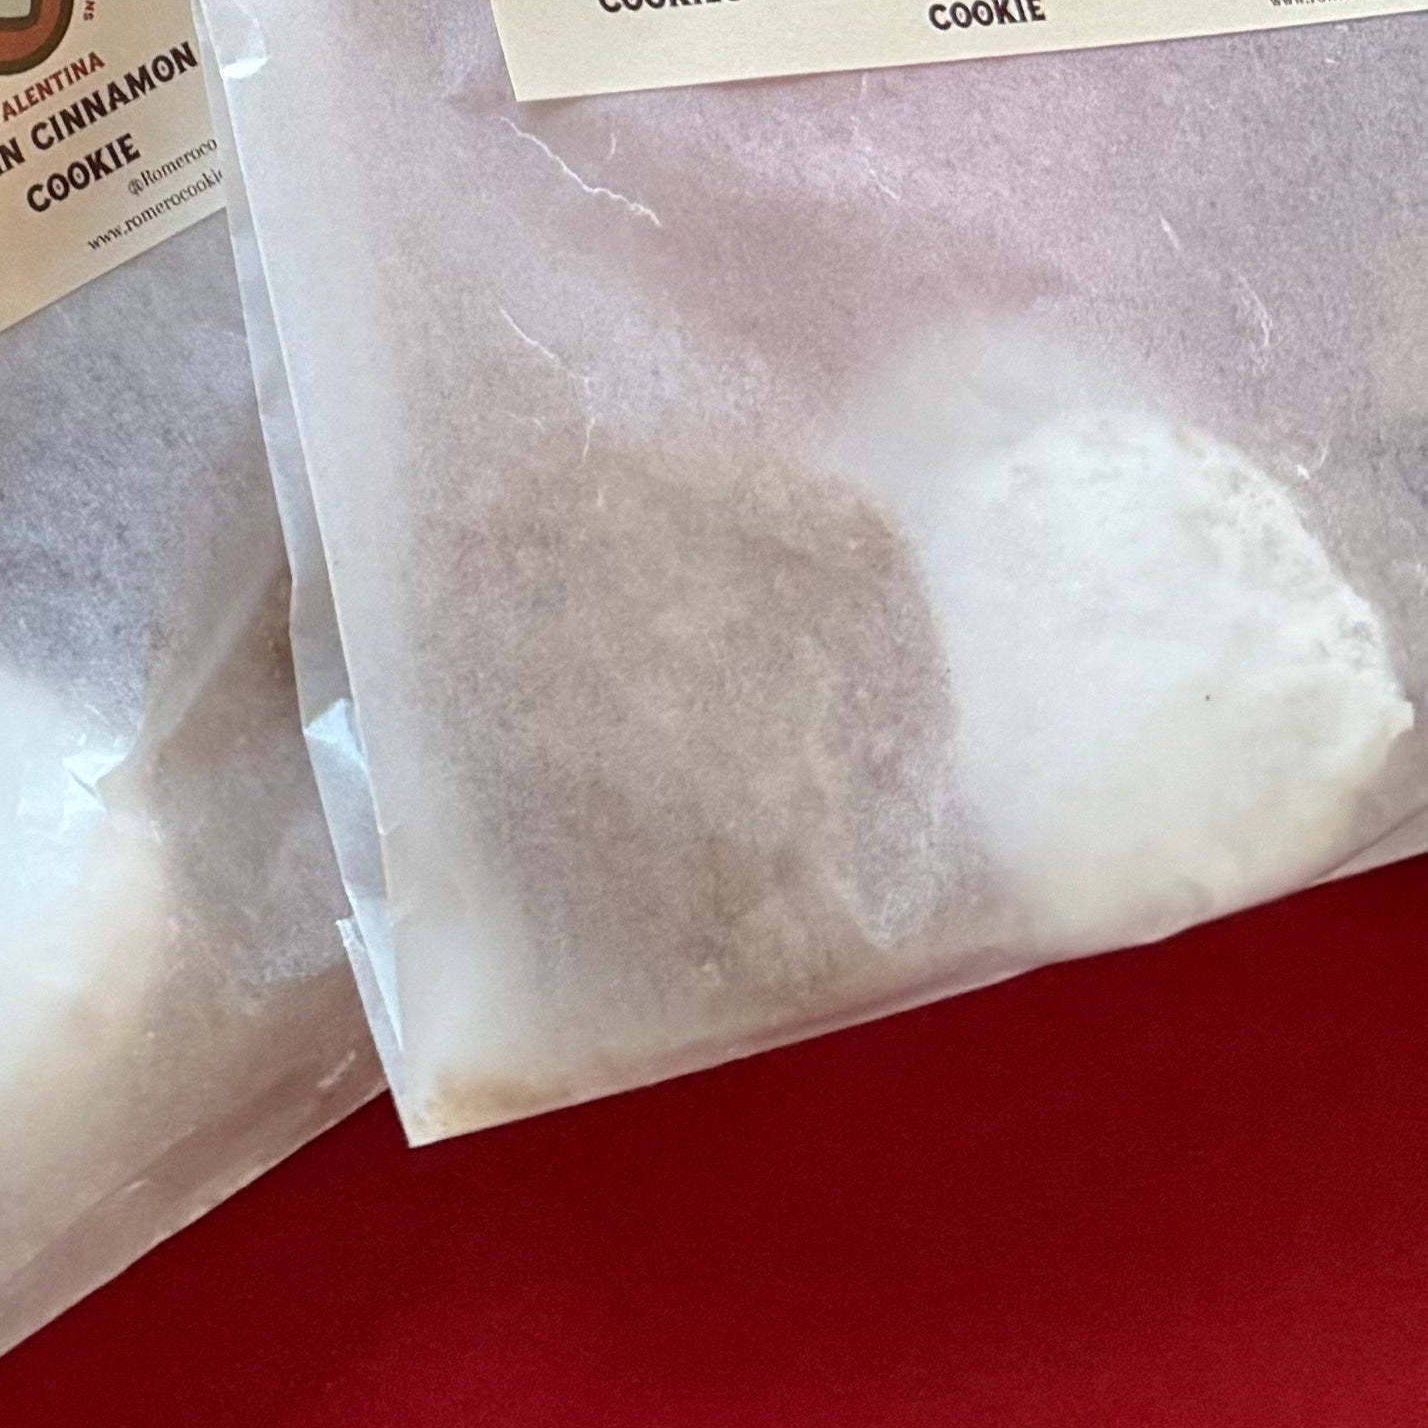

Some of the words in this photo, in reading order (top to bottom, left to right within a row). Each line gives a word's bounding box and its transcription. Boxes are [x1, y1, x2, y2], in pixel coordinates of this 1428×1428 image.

[32, 40, 196, 151] CINNAMON
[28, 132, 139, 213] COOKIE
[128, 138, 218, 197] @Romeroco
[88, 168, 223, 250] www.romerocooki
